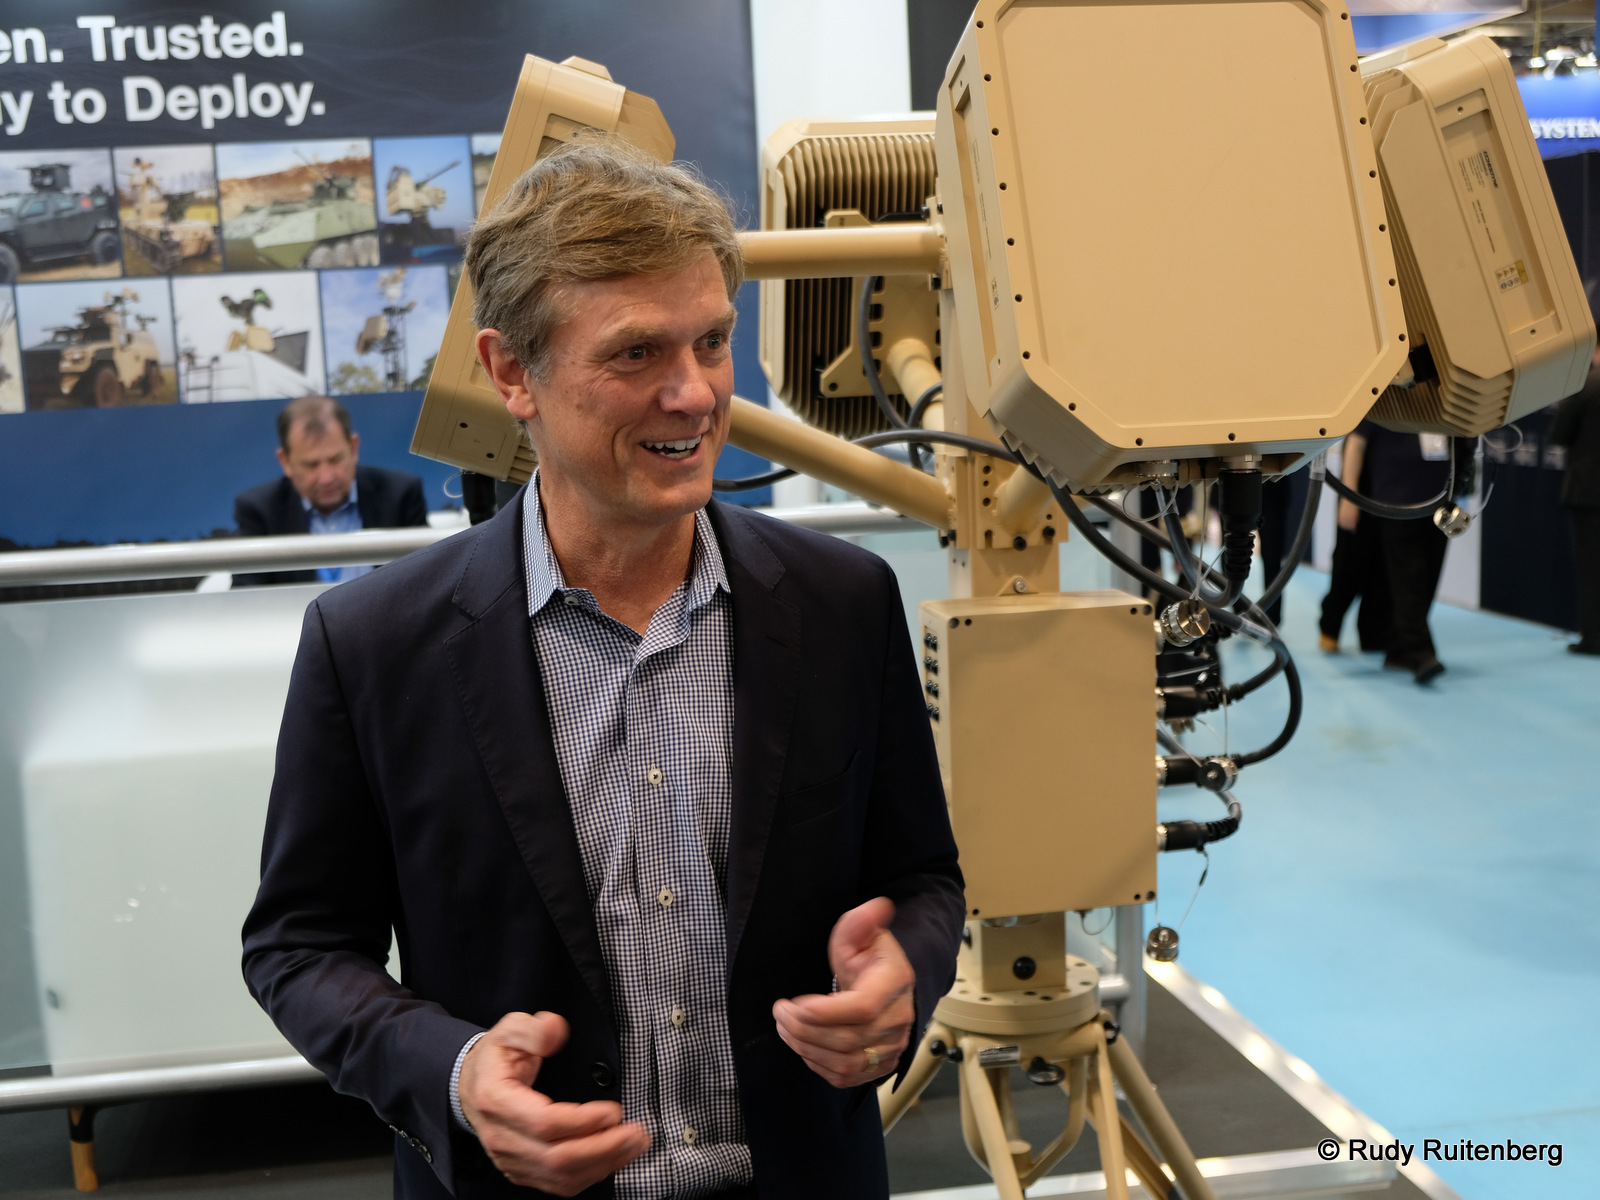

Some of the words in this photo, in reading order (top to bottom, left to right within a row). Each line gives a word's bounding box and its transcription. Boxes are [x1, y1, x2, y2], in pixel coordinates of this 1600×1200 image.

[76, 11, 304, 62] Trusted.
[48, 80, 107, 124] to
[123, 73, 326, 129] Deploy.
